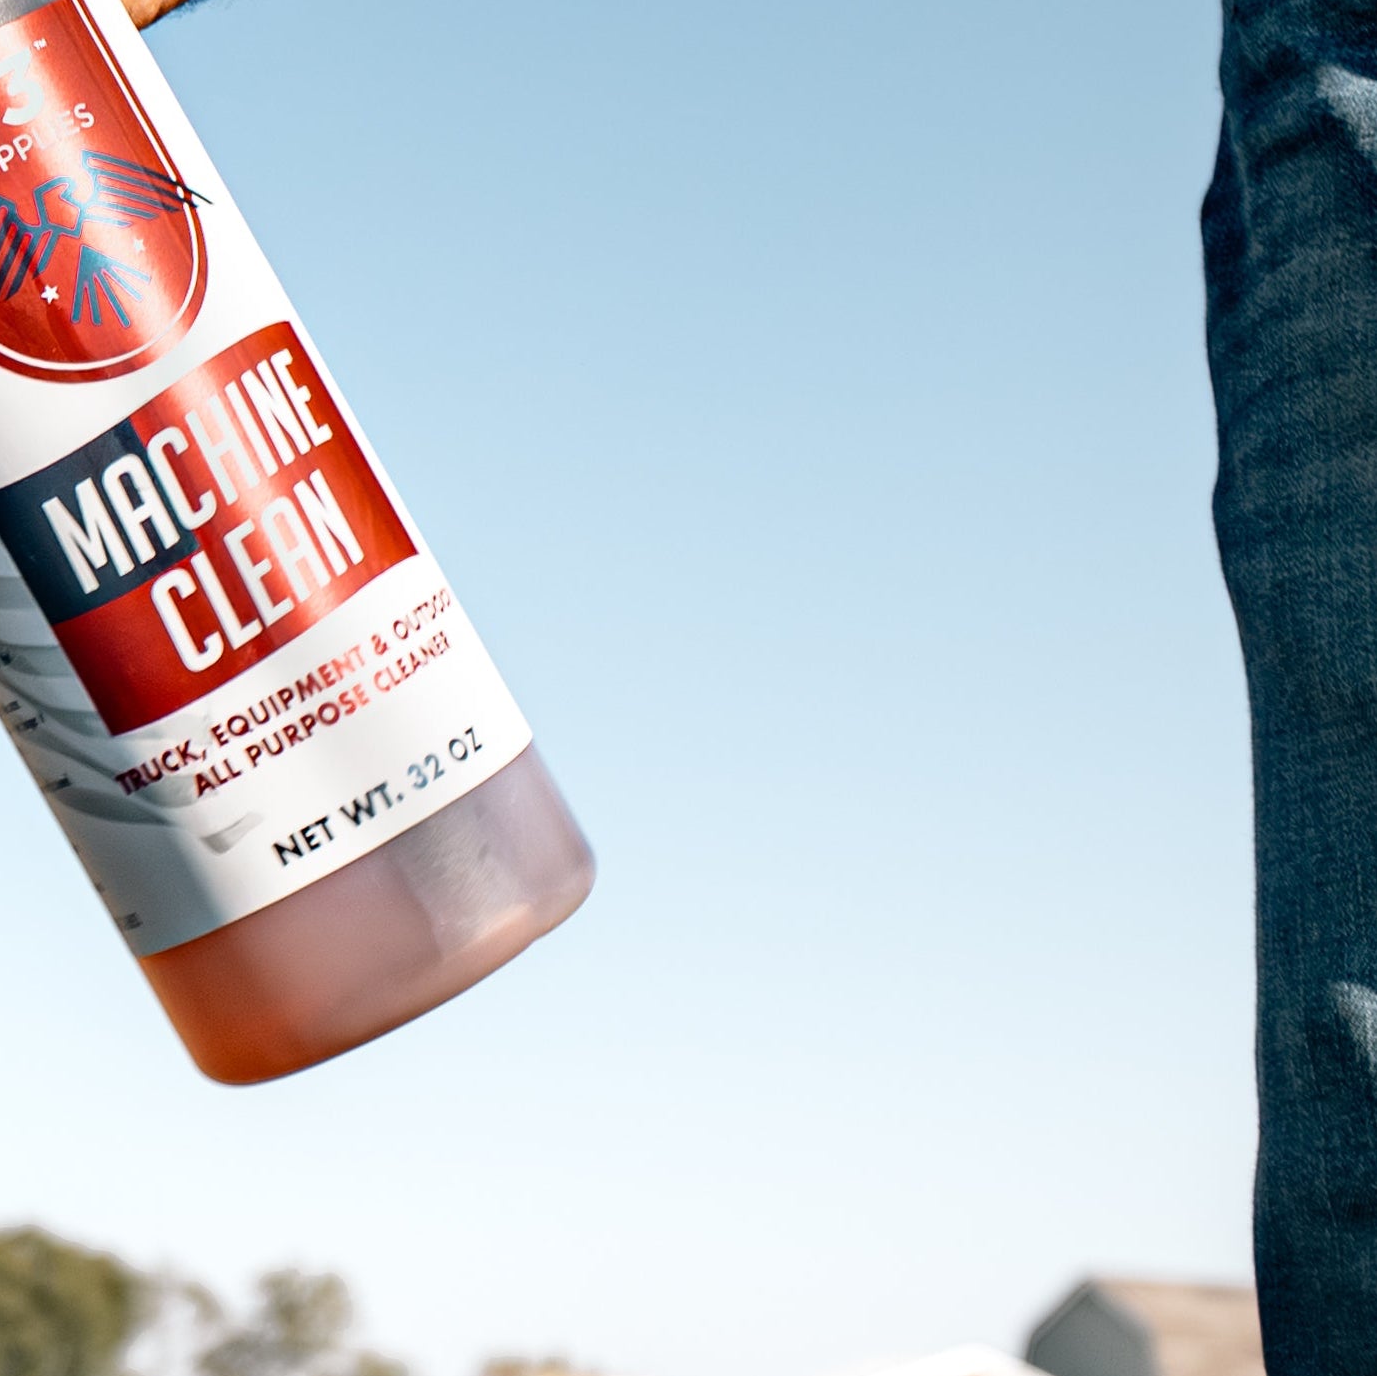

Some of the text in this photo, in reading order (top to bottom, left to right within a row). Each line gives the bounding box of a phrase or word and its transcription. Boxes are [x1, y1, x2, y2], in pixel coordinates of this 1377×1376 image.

[41, 348, 333, 595] MACHINE
[150, 469, 364, 673] CLEAN
[115, 739, 207, 795] TRUCK,
[211, 645, 365, 746] EQUIPMENT
[371, 633, 388, 656] &
[195, 631, 450, 797] ALL PURPOSE CLEANER
[272, 727, 482, 866] NET WT. 32 OZ
